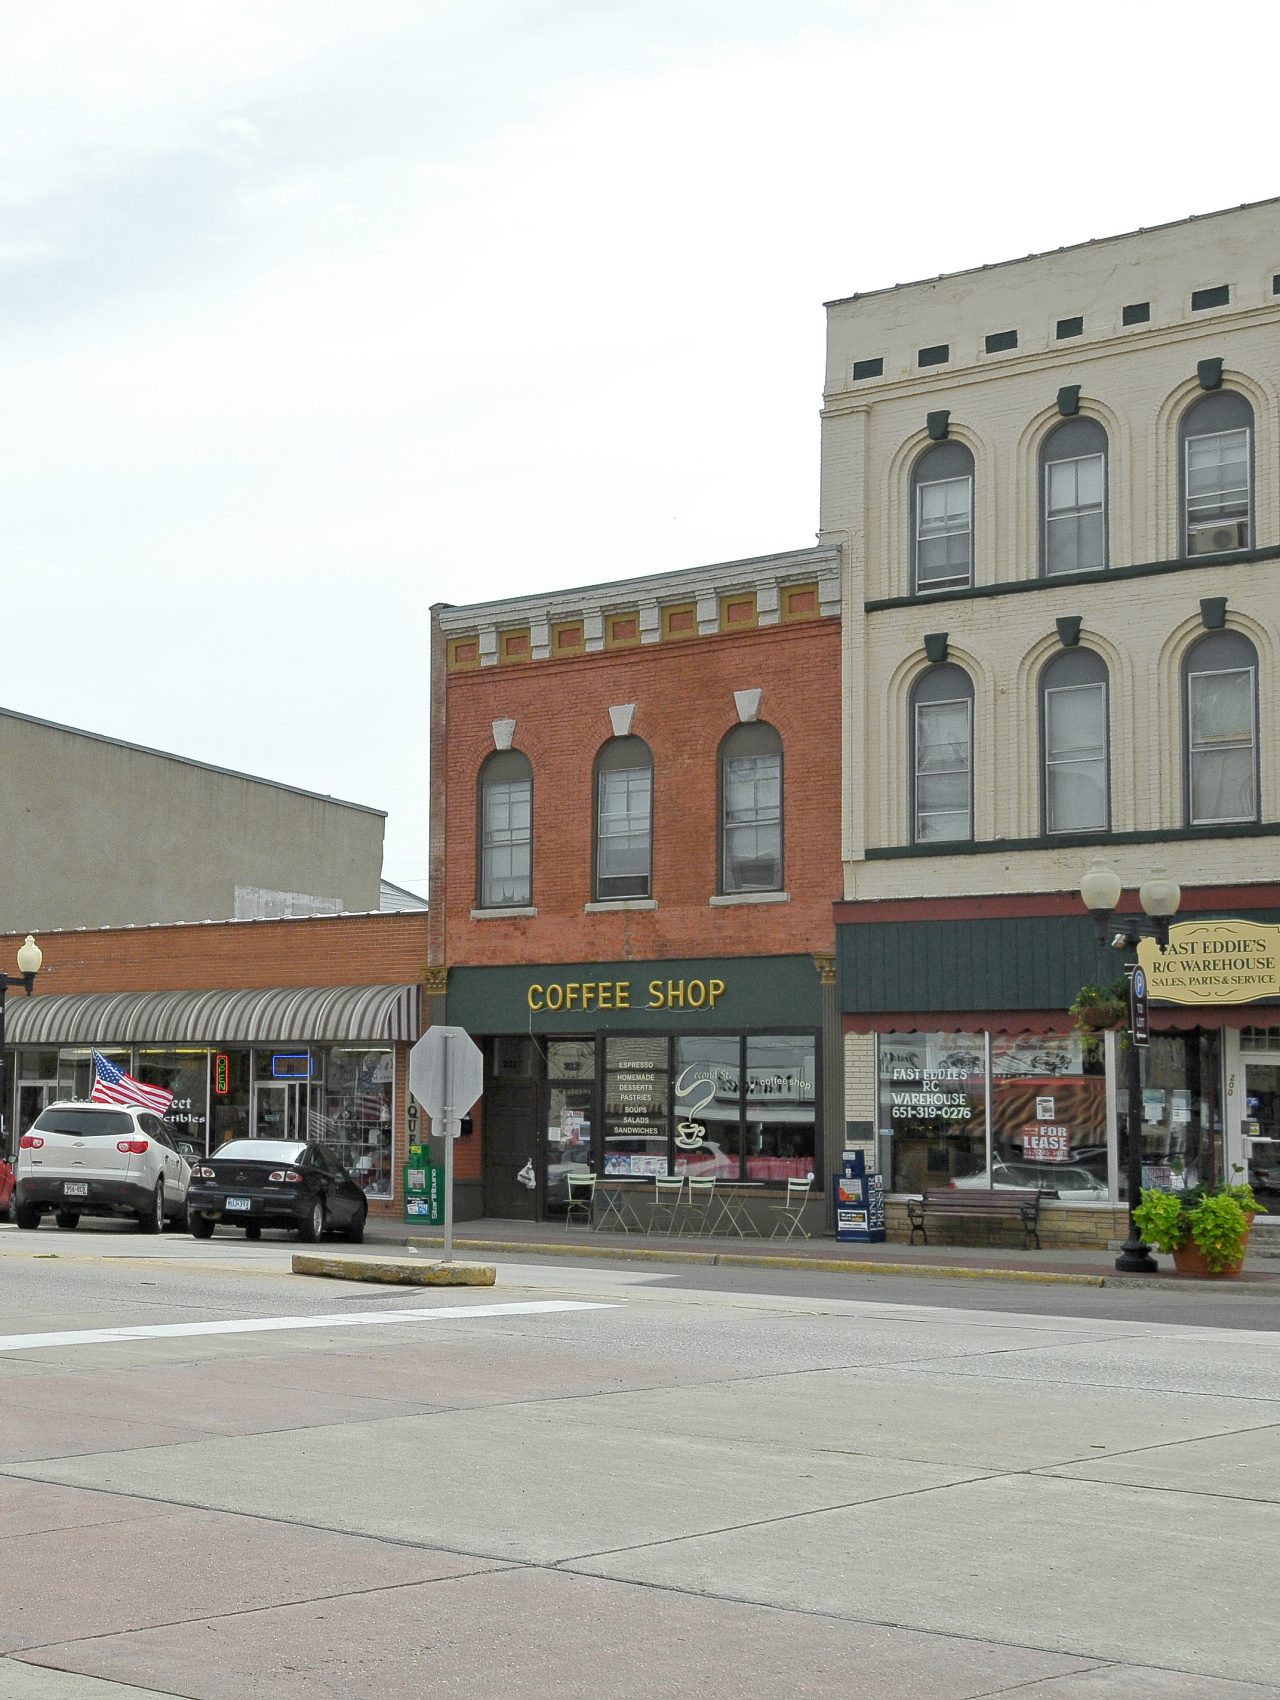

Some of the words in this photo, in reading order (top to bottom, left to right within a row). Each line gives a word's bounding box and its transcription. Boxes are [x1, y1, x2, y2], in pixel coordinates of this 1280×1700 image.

[1203, 939, 1266, 954] EDDIE'S
[1152, 961, 1176, 973] R/C
[1181, 957, 1275, 972] WAREHOUSE
[1152, 979, 1187, 987] SALES,
[1189, 976, 1220, 985] PARTS
[1221, 976, 1229, 984] &
[1231, 975, 1275, 984] SERVICE
[528, 981, 630, 1009] COFFEE
[648, 979, 724, 1007] SHOP
[218, 1057, 226, 1091] OPEN
[893, 1069, 920, 1080] FAST
[923, 1069, 967, 1080] EDDIES
[760, 1076, 788, 1086] coffee
[789, 1077, 812, 1090] shop
[923, 1081, 939, 1091] RC
[891, 1093, 966, 1105] WAREHOUSE
[892, 1106, 971, 1118] 651-319-0276
[1040, 1126, 1067, 1137] FOR
[1023, 1135, 1068, 1150] LEASE
[868, 1177, 877, 1231] PIONEER
[875, 1192, 885, 1230] PRESS
